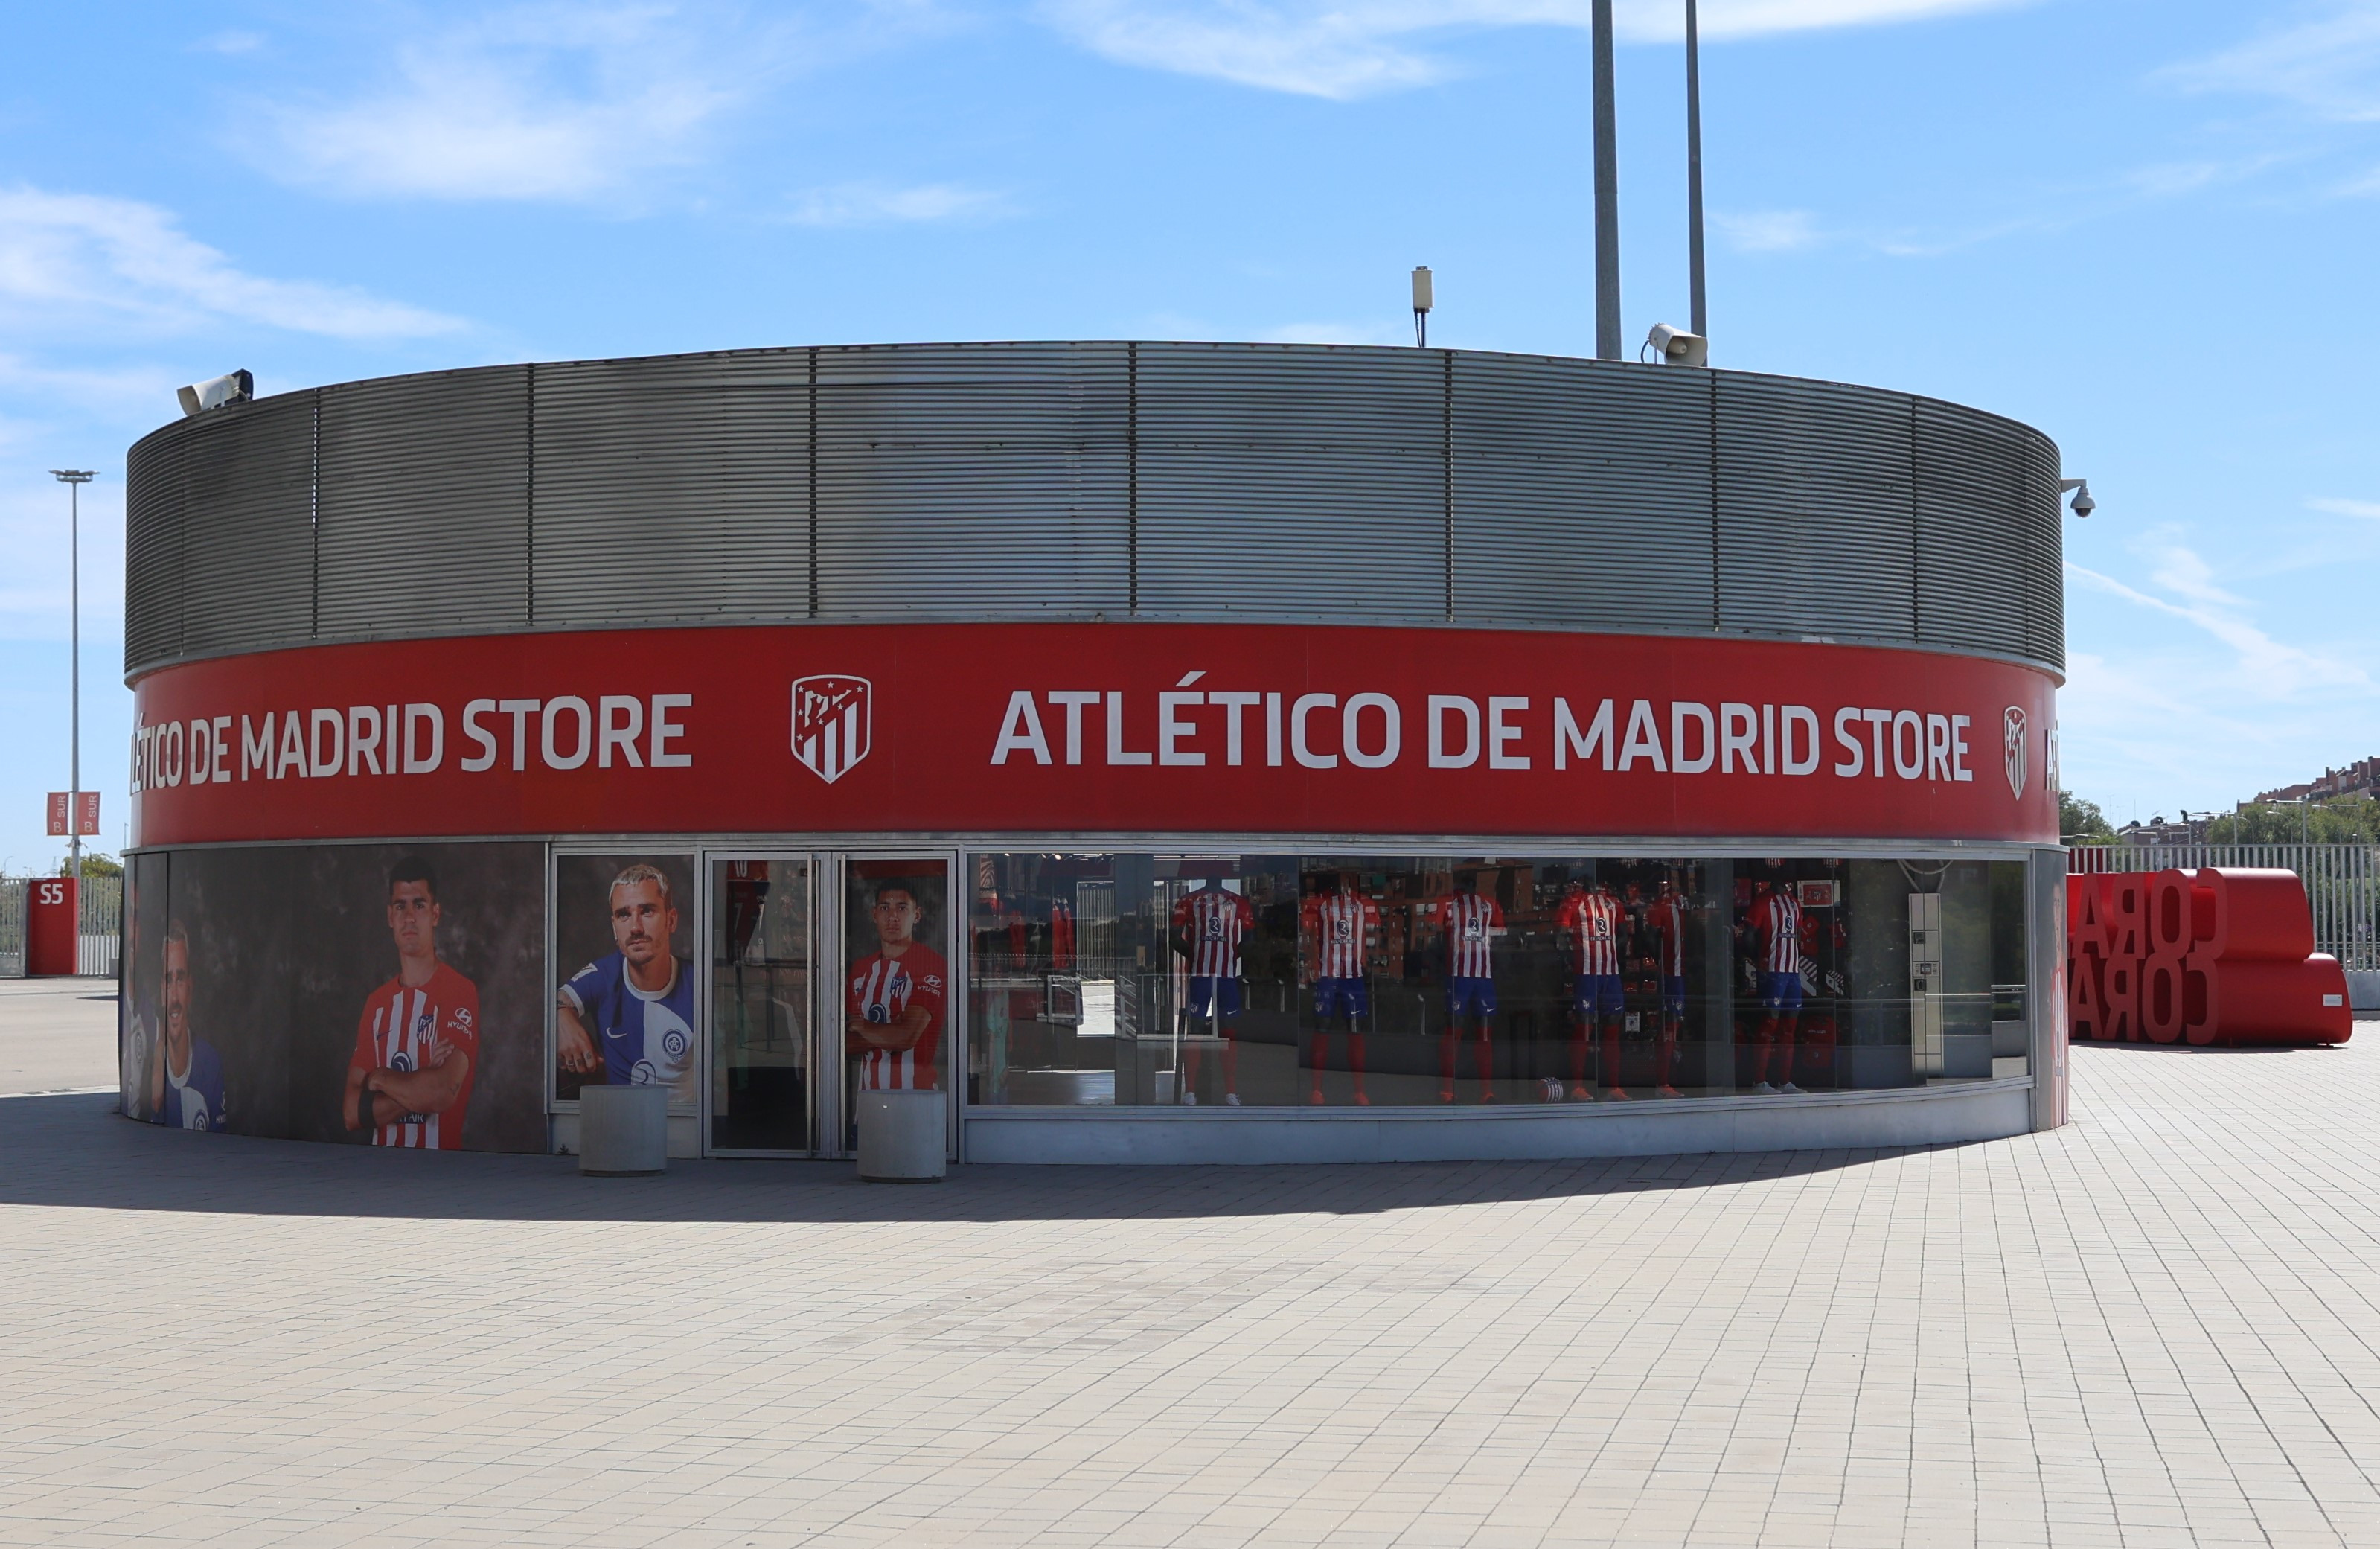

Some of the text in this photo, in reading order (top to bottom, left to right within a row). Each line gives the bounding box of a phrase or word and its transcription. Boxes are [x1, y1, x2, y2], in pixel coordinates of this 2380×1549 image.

[990, 671, 1973, 782] ATLÉTICO DE MADRID STORE
[190, 715, 231, 785] DE
[241, 703, 444, 781] MADRID
[461, 694, 692, 771] STORE
[57, 796, 66, 818] SUR
[89, 795, 97, 817] SUR
[39, 883, 63, 904] S5
